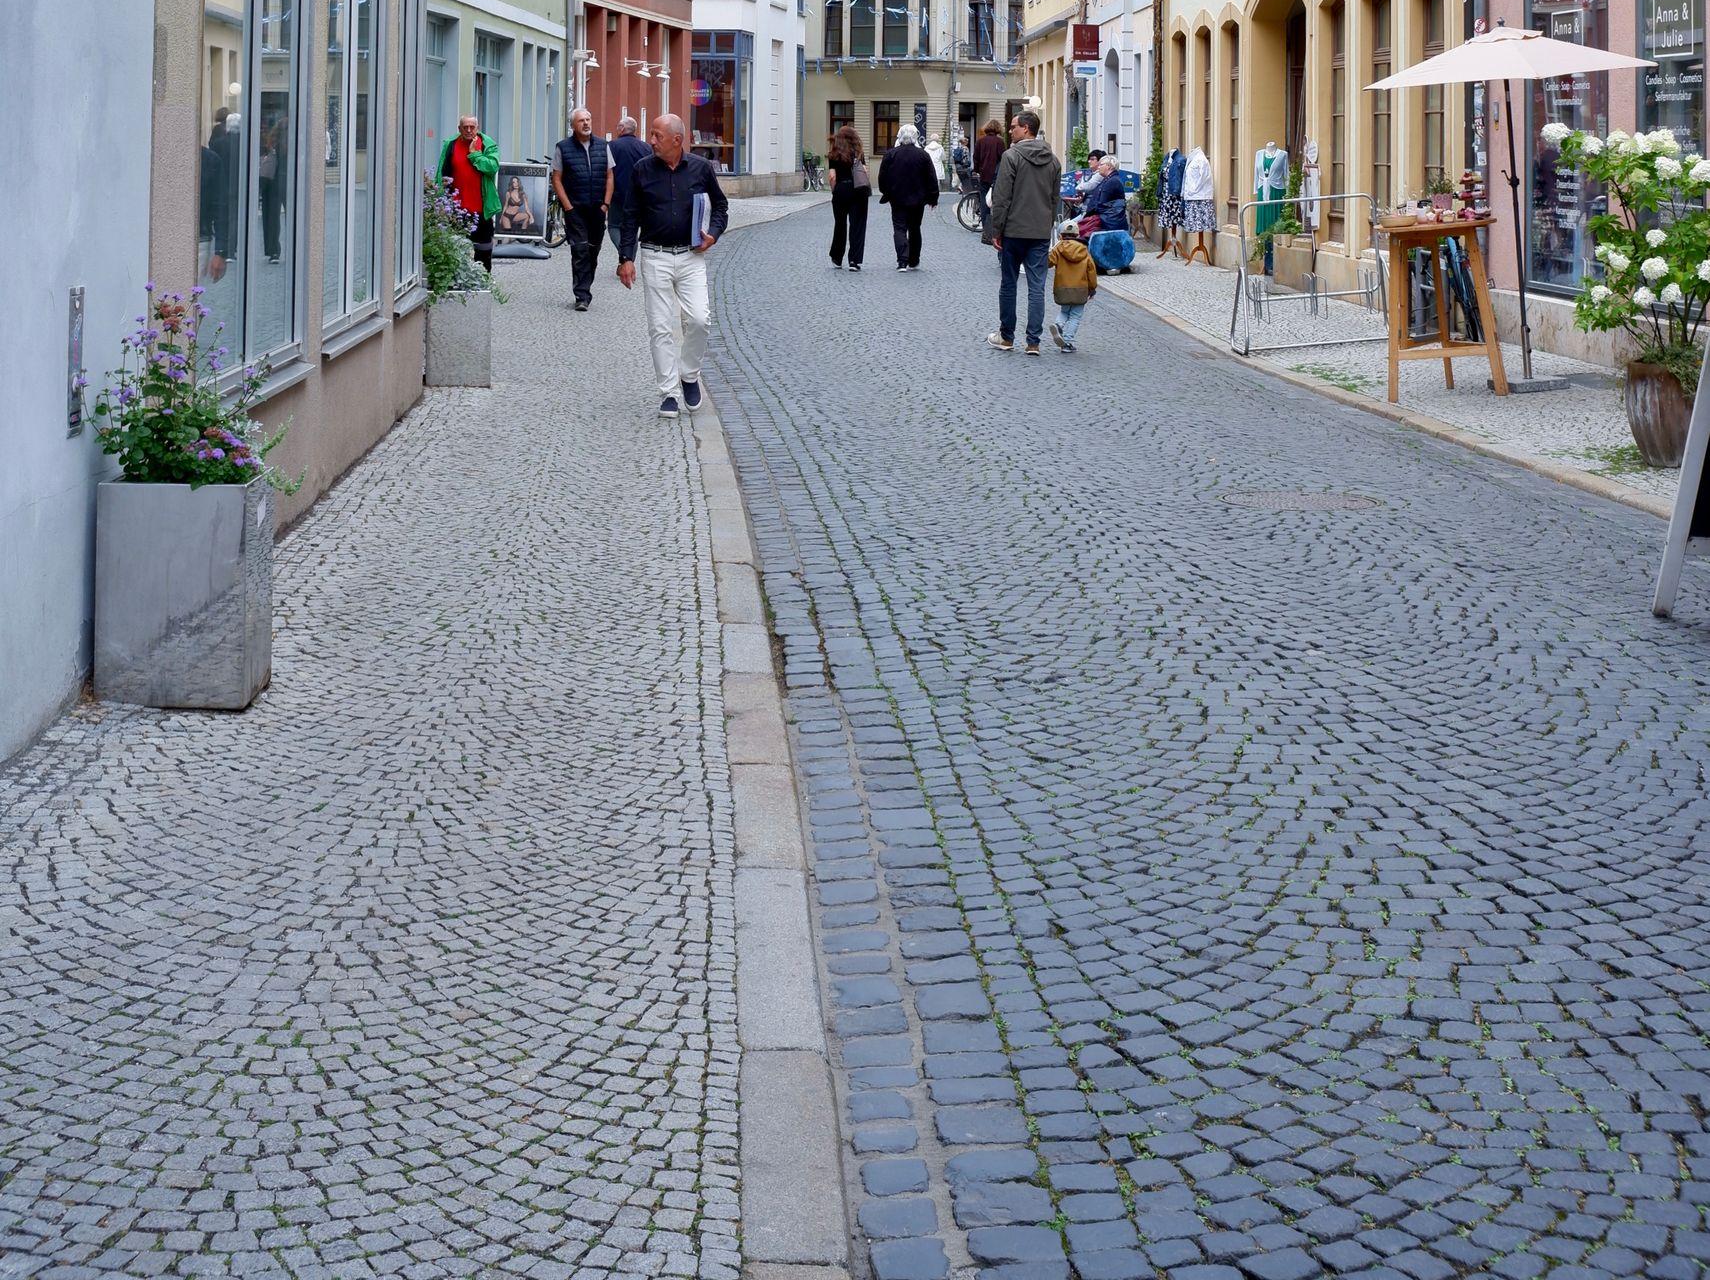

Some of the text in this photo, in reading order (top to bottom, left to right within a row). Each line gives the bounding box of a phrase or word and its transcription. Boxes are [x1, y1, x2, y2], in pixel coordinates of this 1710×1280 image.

[1656, 2, 1689, 23] Anna &
[1553, 17, 1580, 36] Anna &
[1661, 30, 1684, 48] Julie
[1645, 72, 1703, 86] Candles Soap Cosmetics
[1545, 80, 1591, 93] Candles Soap Cosmetics
[1654, 90, 1692, 102] Seifenmanufaktur
[523, 167, 546, 176] sassa
